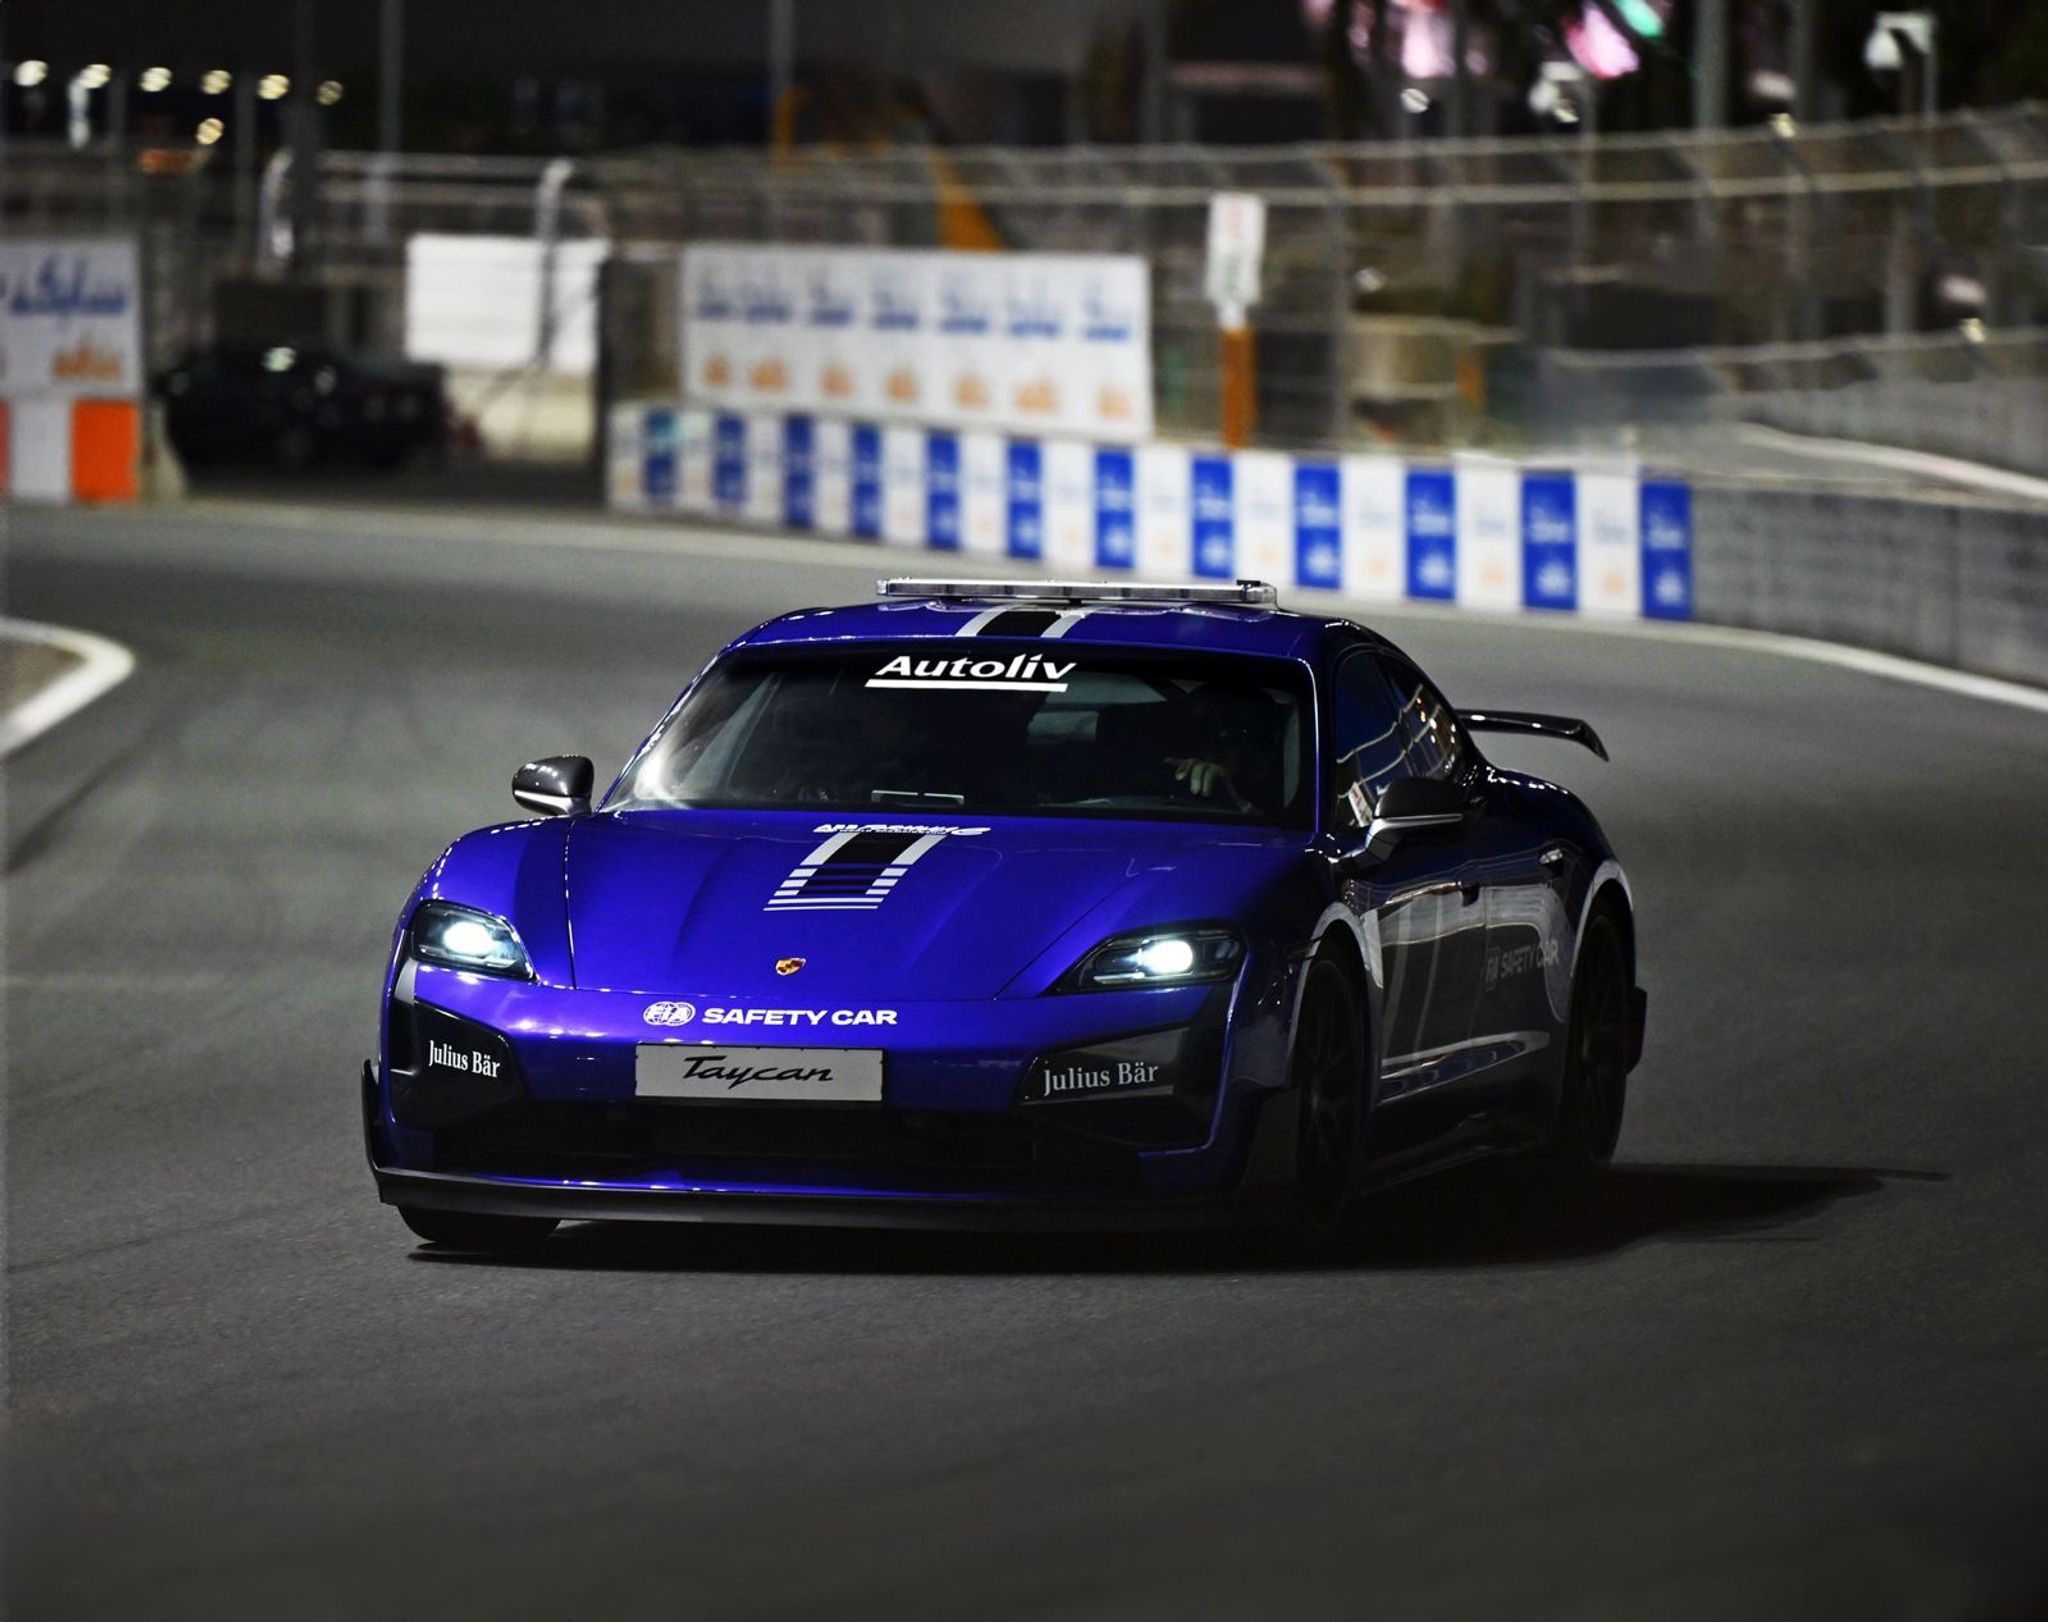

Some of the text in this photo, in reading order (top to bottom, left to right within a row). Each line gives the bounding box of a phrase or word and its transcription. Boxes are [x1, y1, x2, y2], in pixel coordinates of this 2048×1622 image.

[875, 653, 1077, 679] Autoliv
[1536, 939, 1560, 969] CAR
[645, 1003, 898, 1025] FIA SAFETY CAR
[428, 1039, 501, 1078] Julius Bär
[684, 1056, 833, 1089] Taycan
[1043, 1061, 1159, 1097] Julius Bär
